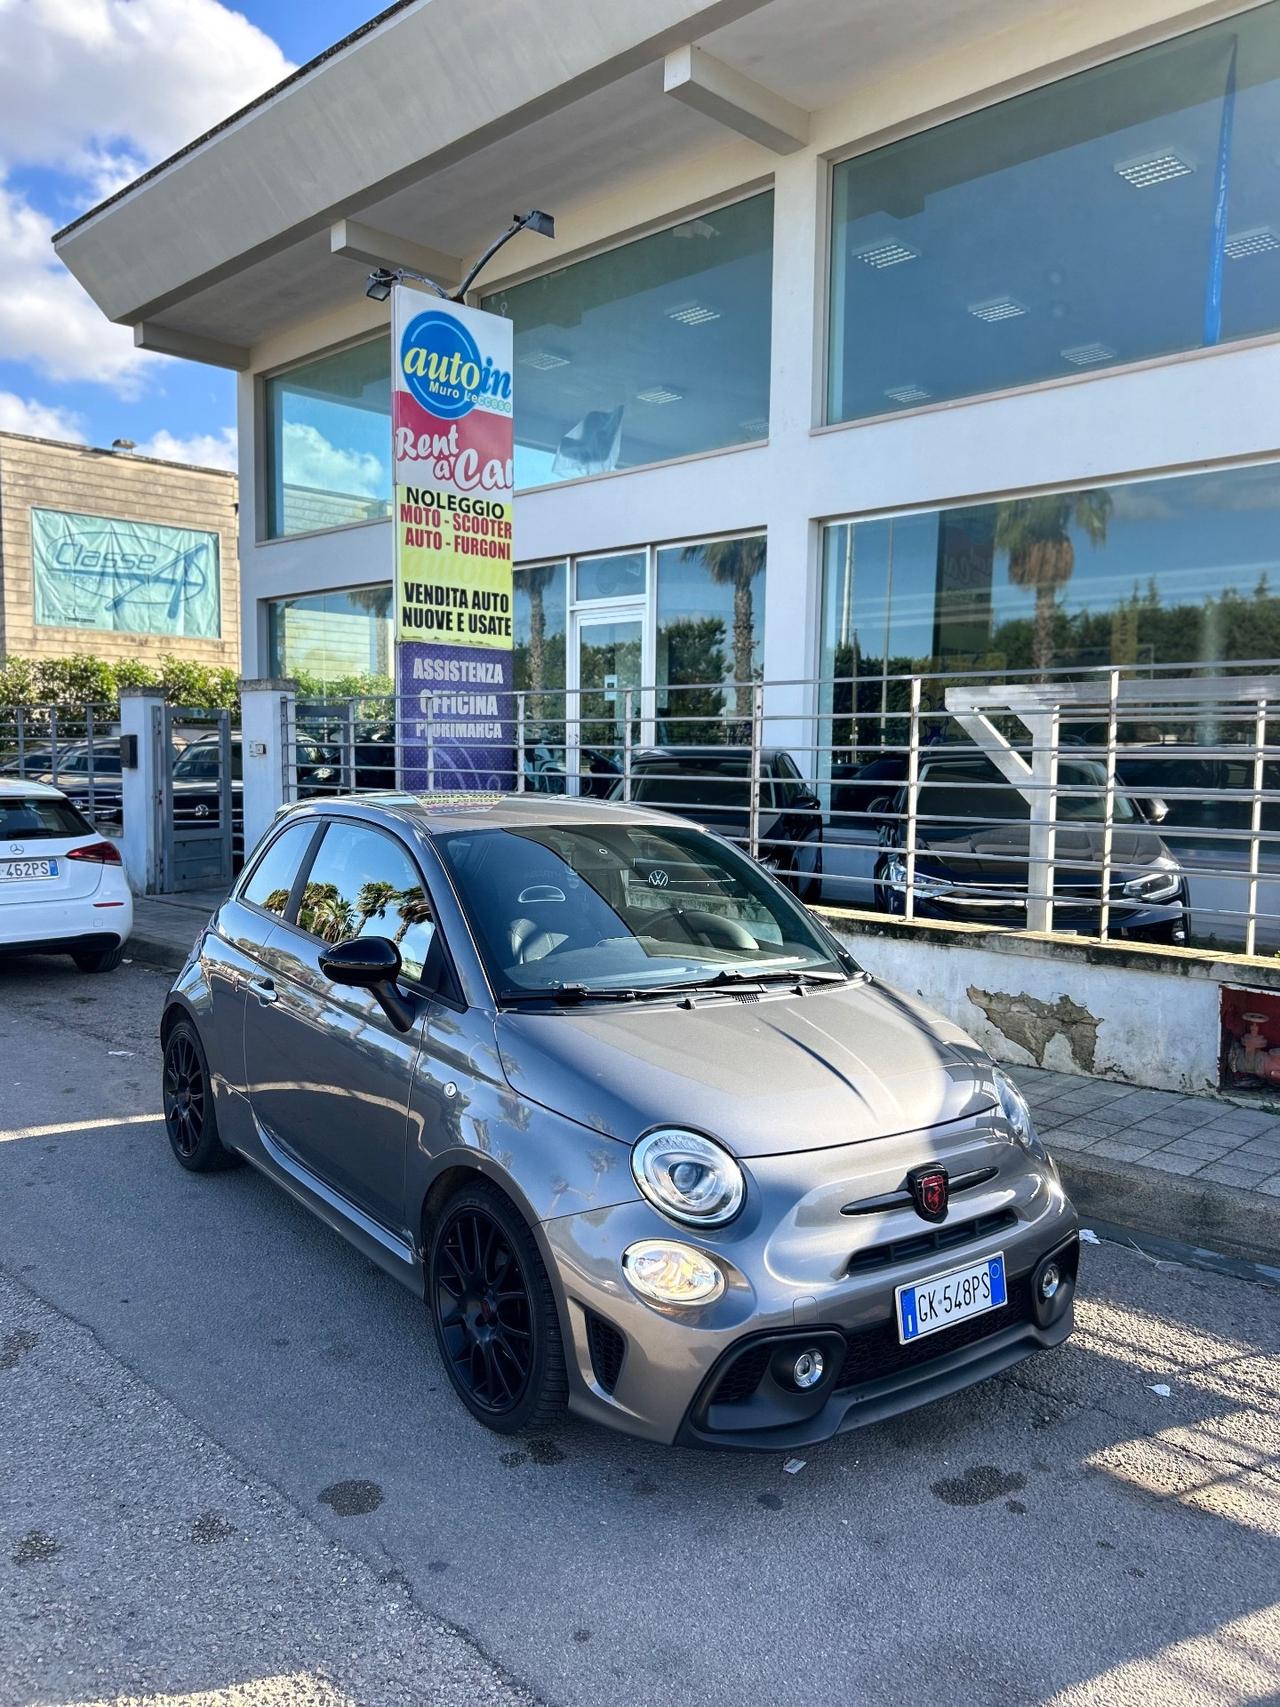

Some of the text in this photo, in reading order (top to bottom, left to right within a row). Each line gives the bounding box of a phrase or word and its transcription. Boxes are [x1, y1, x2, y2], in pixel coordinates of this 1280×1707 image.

[429, 381, 460, 399] Muro
[395, 424, 459, 459] Rent
[406, 487, 504, 519] NOLEGGIO
[400, 504, 441, 528] MOTO
[453, 513, 512, 539] SCOOTER
[55, 542, 157, 571] Classe
[405, 527, 442, 550] AUTO
[454, 537, 511, 560] FURGONI
[403, 581, 509, 613] VENDITA AUTO
[402, 606, 512, 637] NUOVE E USATE
[412, 658, 504, 684] ASSISTENZA
[420, 688, 499, 716] OFFICINA
